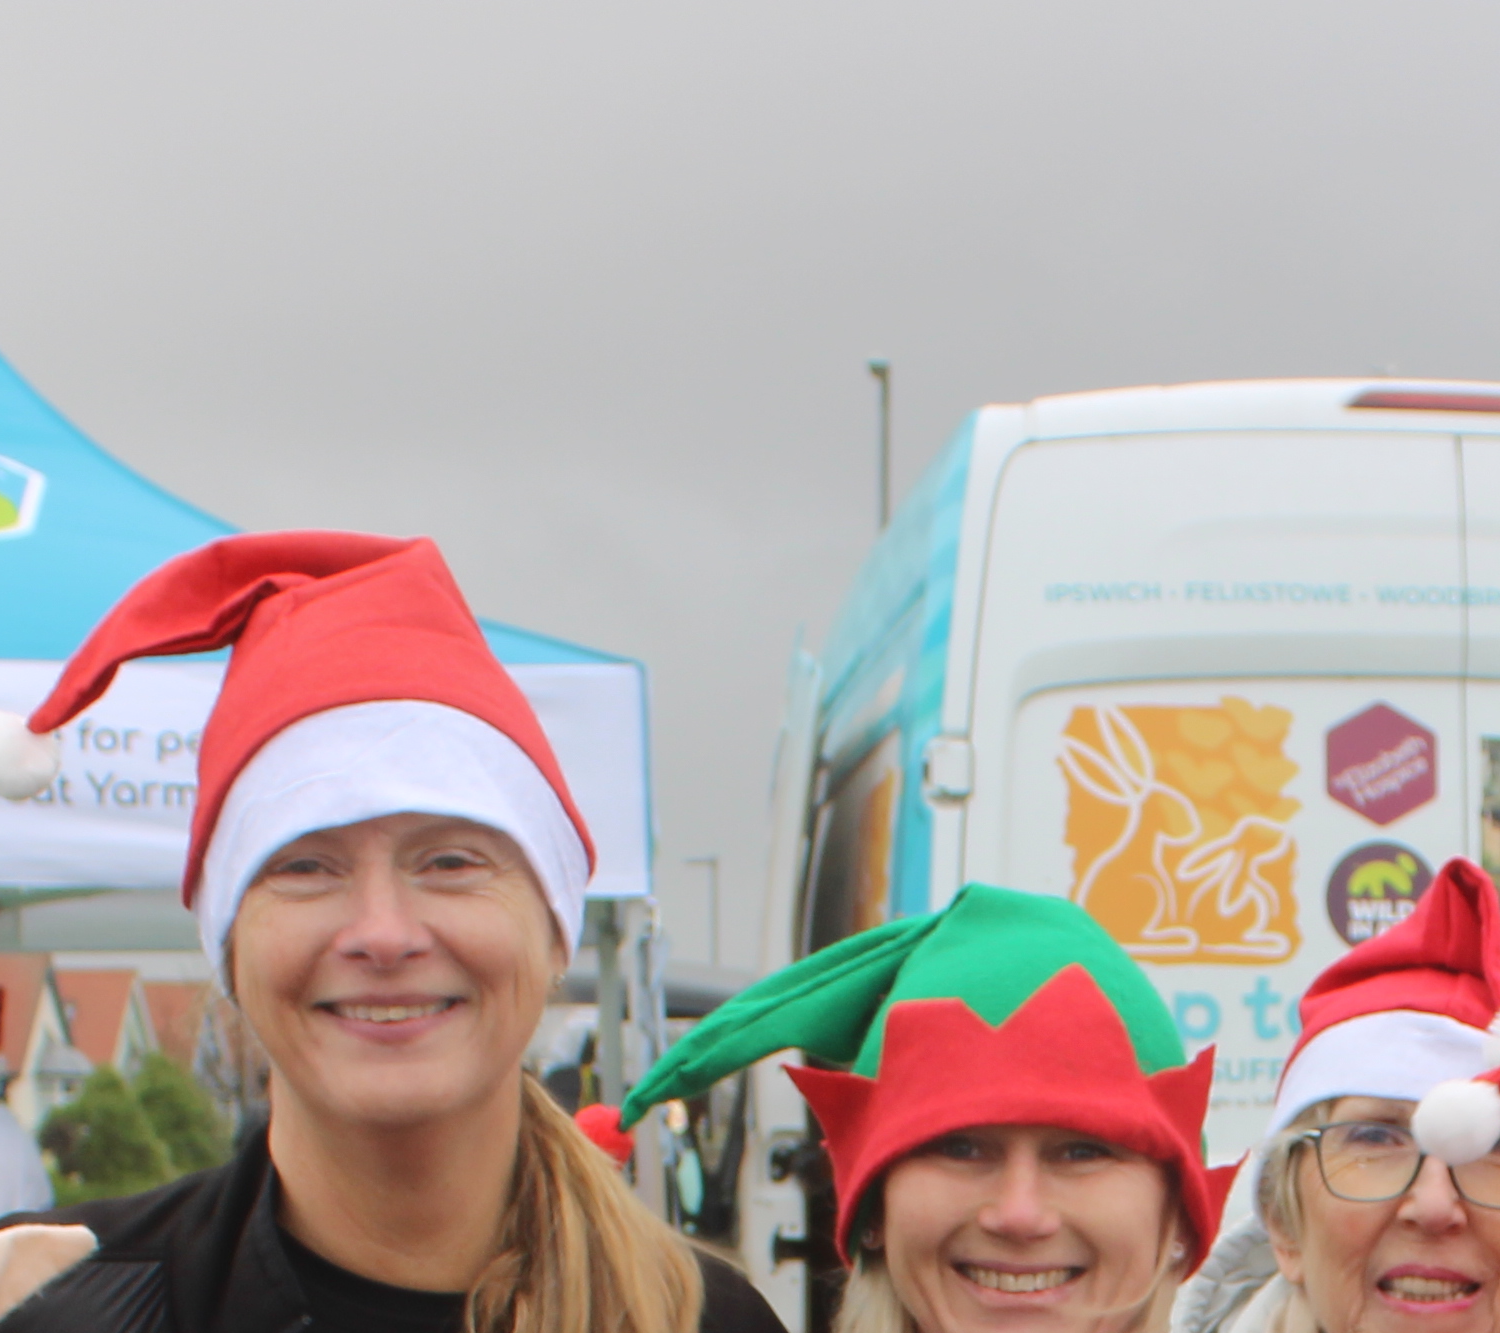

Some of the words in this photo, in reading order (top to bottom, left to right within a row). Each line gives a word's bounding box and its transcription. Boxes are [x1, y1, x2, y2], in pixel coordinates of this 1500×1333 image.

[1043, 582, 1162, 604] IPSWICH
[1185, 582, 1352, 605] FELIXSTOWE
[77, 718, 140, 754] for
[156, 731, 200, 761] pe
[85, 771, 197, 807] Yarm
